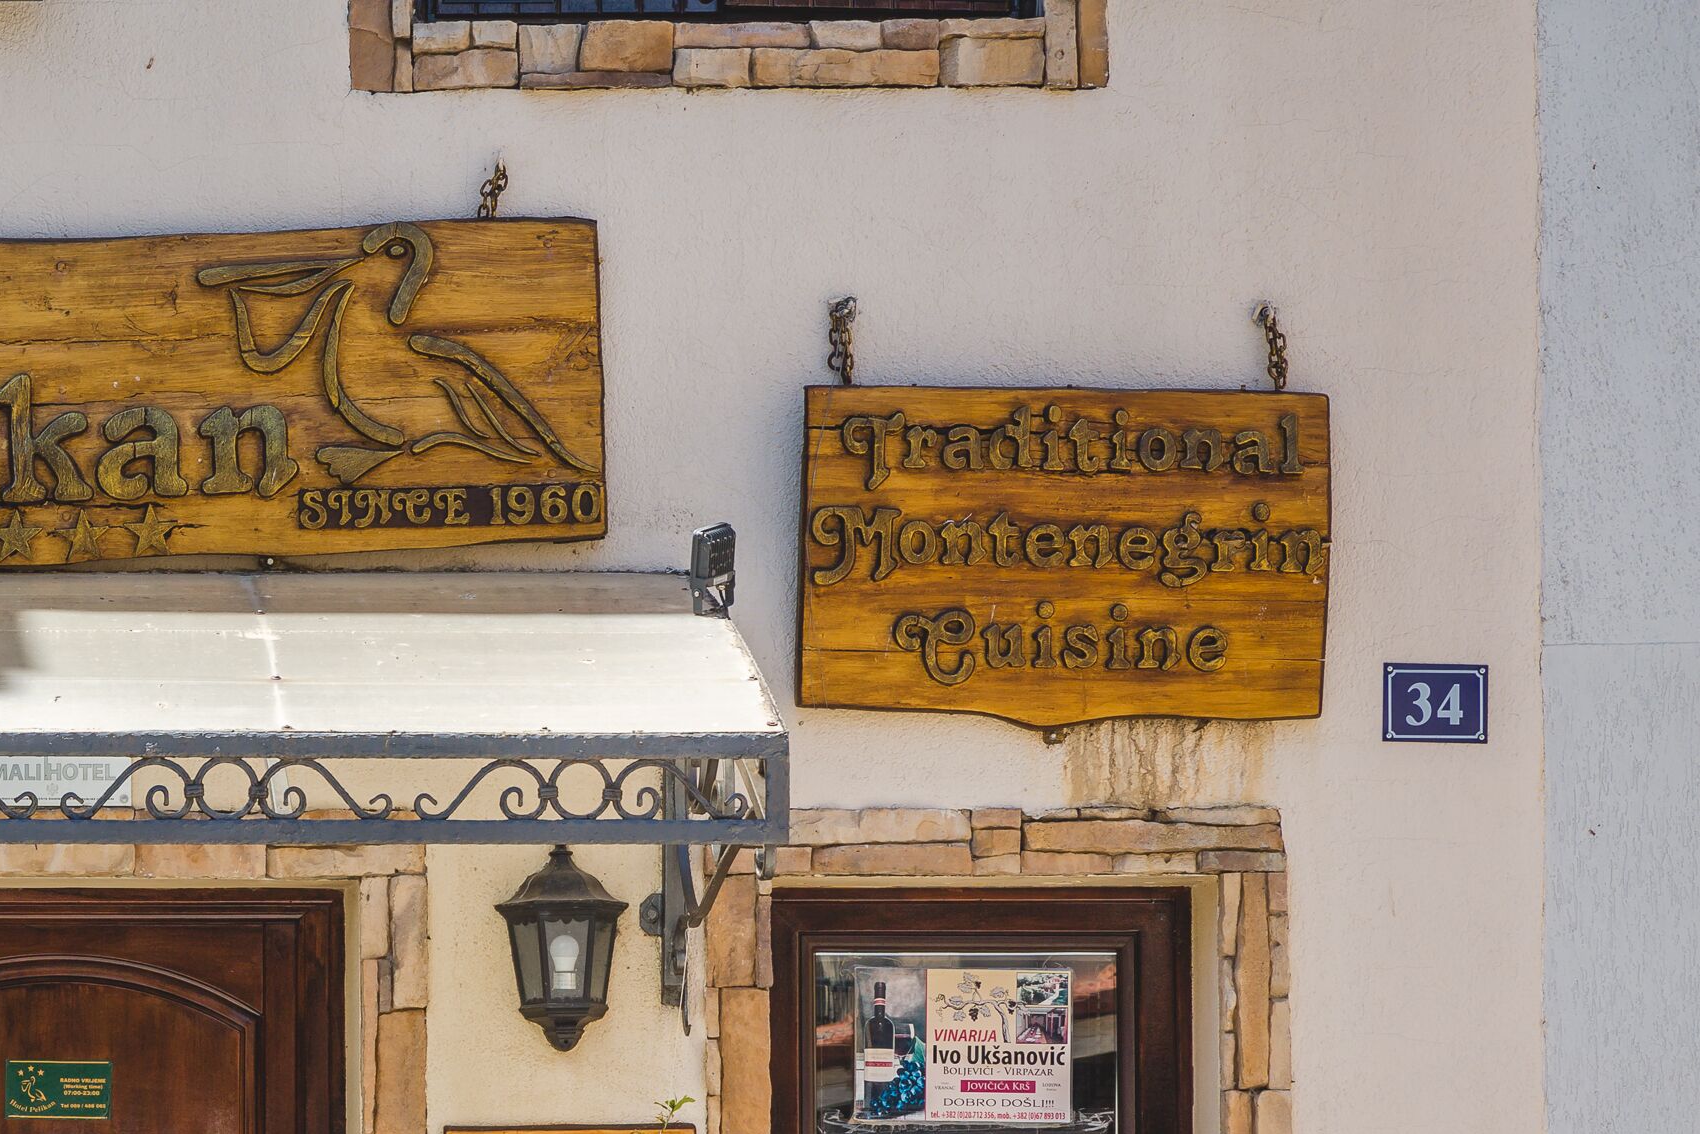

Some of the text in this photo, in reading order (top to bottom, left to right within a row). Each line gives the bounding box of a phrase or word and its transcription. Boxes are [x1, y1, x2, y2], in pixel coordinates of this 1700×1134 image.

[841, 404, 1305, 492] Traditional
[299, 484, 601, 530] SINCE 1960
[812, 501, 1325, 588] Montenegrin
[894, 600, 1230, 686] Cuisine
[1405, 682, 1464, 726] 34
[934, 1029, 997, 1042] VINARIJA
[932, 1045, 1066, 1066] Ivo Ukšanović
[10, 1099, 57, 1113] Hotel Pelikan
[943, 1096, 1055, 1108] DOBRO DOŠLI!!!
[1012, 1112, 1027, 1120] +382
